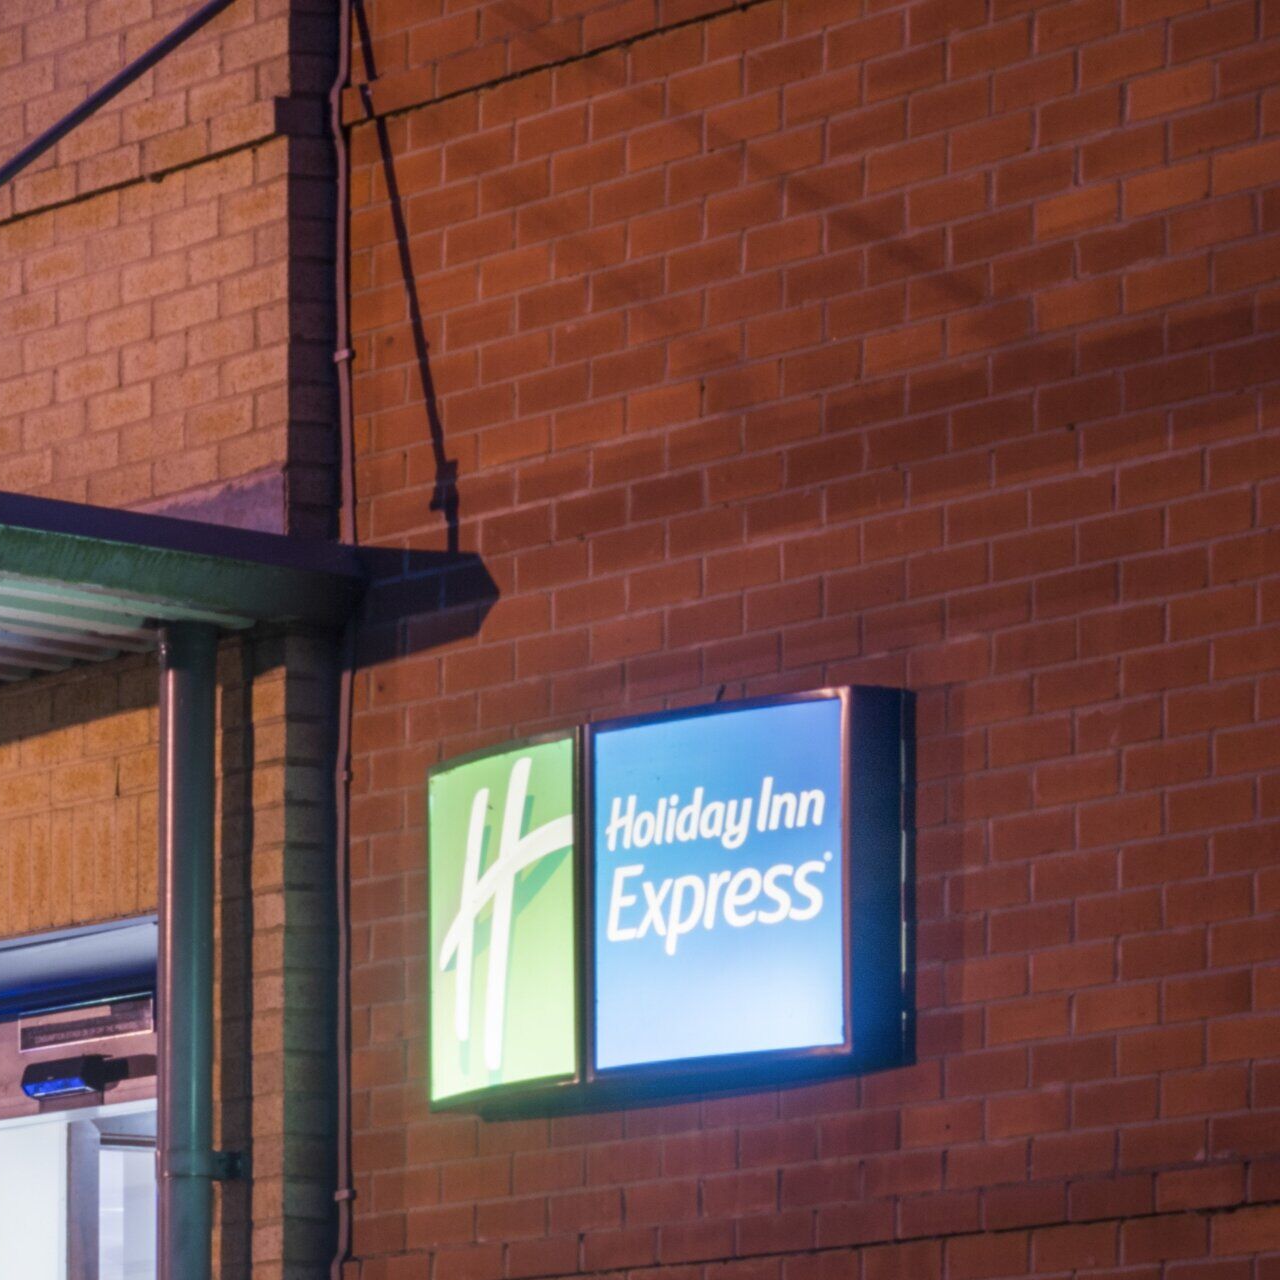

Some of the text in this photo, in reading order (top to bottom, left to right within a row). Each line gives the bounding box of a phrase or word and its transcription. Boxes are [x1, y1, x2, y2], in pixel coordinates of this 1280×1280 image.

[606, 776, 825, 852] Holiday Inn
[606, 860, 826, 955] Express
